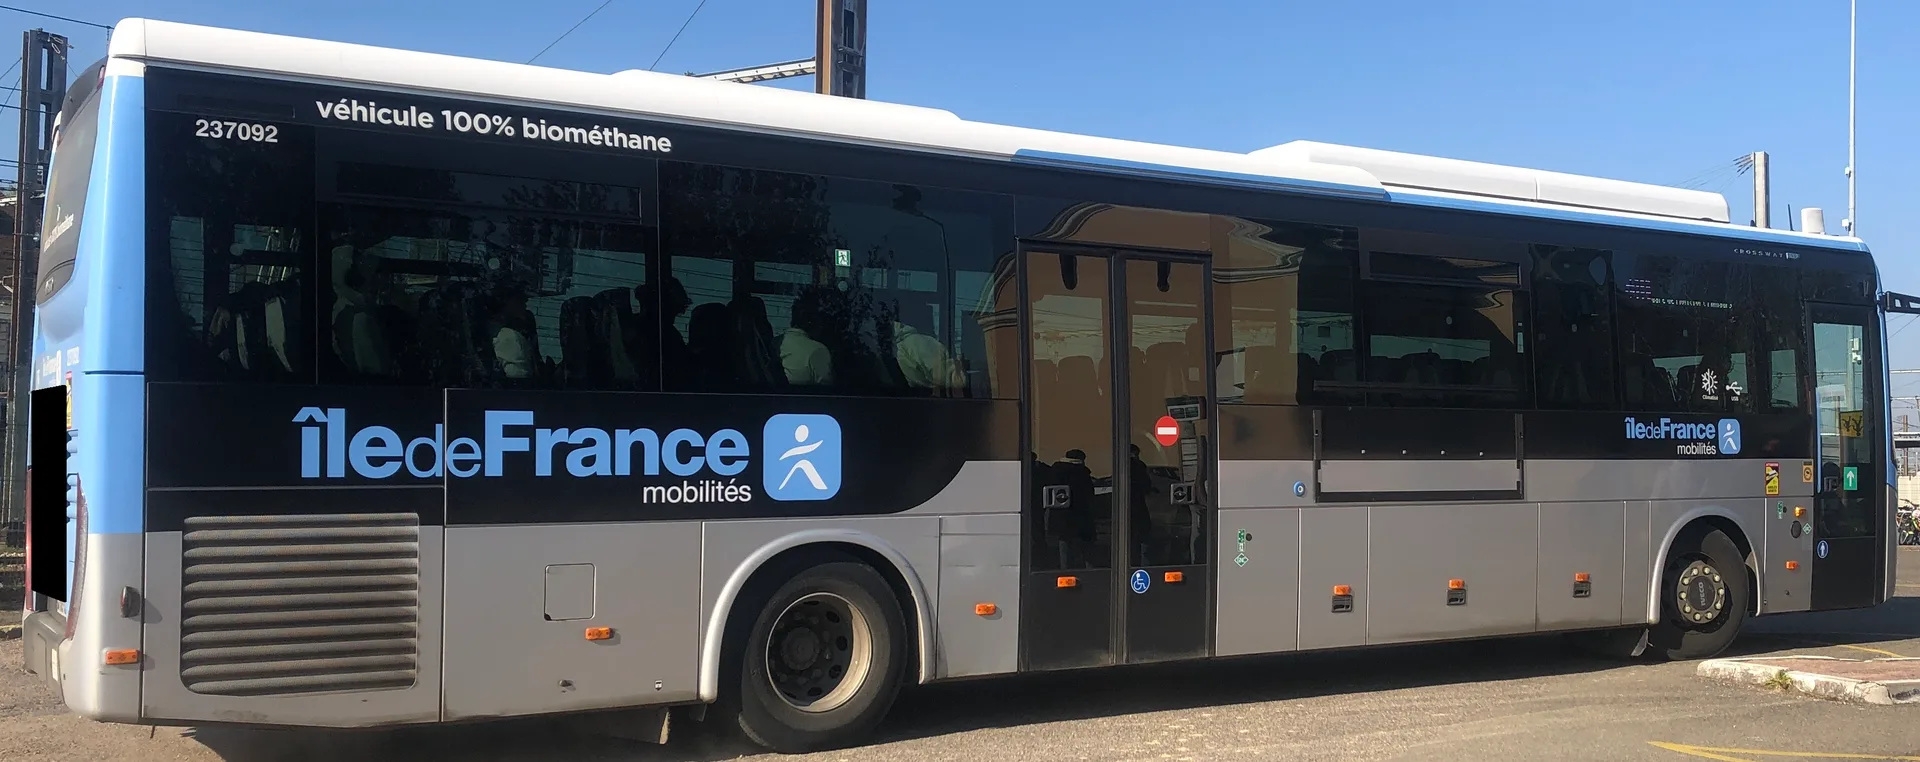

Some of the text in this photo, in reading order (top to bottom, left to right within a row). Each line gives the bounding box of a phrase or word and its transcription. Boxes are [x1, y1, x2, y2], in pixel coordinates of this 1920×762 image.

[195, 119, 278, 143] 237092
[316, 100, 672, 153] véhicule 100% biométhane
[1733, 248, 1783, 258] CROSSWAY
[1676, 441, 1717, 455] mobilités
[643, 478, 752, 504] mobilités
[1698, 581, 1706, 606] IVECO
